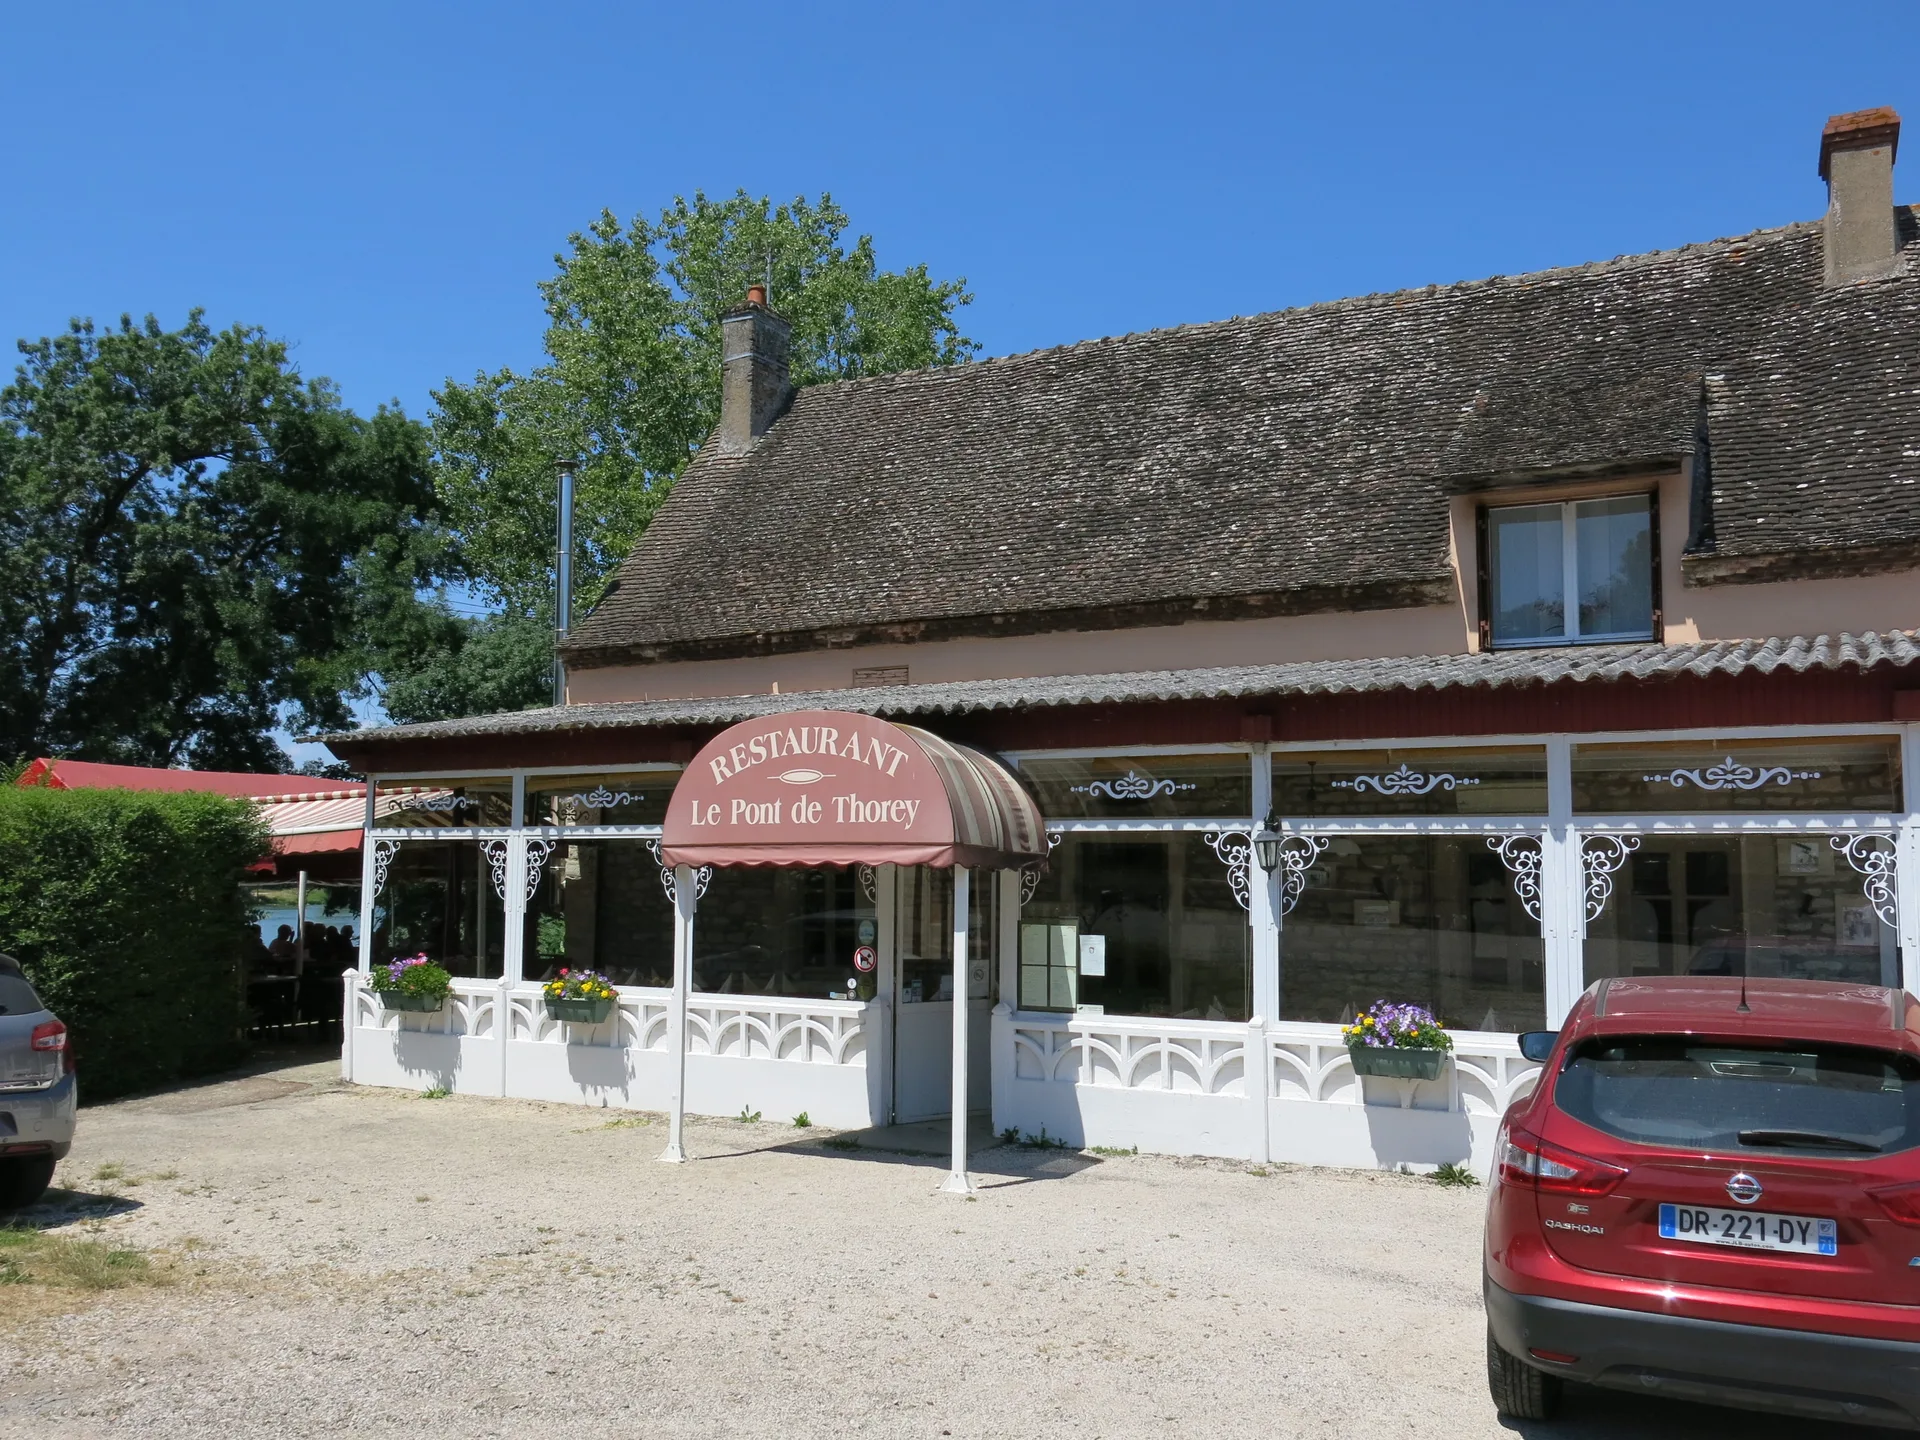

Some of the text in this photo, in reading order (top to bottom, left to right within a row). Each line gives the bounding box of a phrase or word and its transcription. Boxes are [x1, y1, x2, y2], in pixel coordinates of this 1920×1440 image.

[708, 726, 909, 785] RESTAURANT
[691, 793, 920, 830] Le Pont de Thorey
[1679, 1209, 1811, 1245] DR-221-DY
